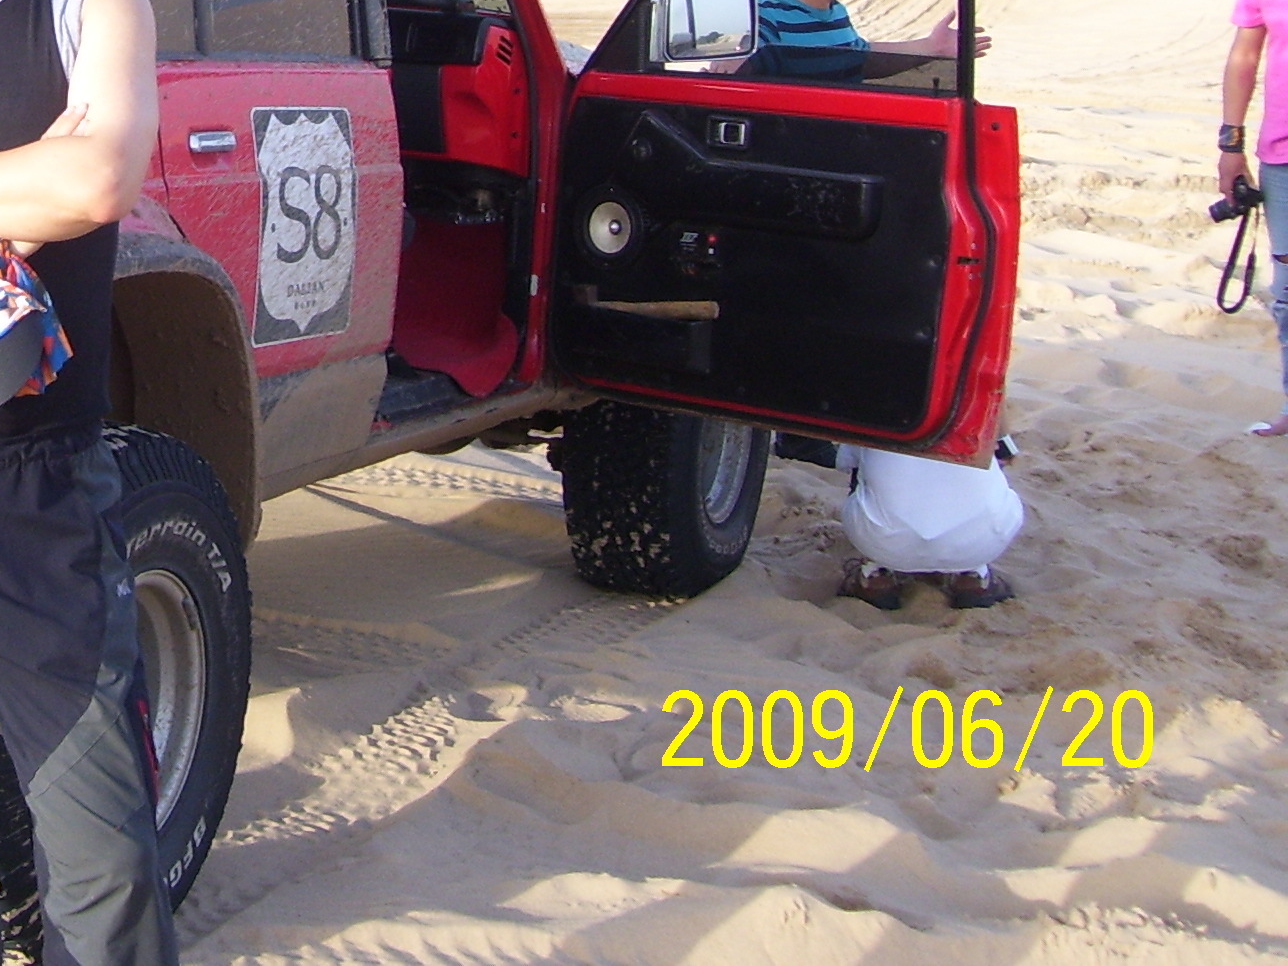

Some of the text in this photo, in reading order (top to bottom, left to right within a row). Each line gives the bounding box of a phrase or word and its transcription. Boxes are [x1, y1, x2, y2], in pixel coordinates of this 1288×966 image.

[276, 164, 342, 263] S8
[207, 543, 232, 592] T/A
[164, 815, 208, 888] BFG
